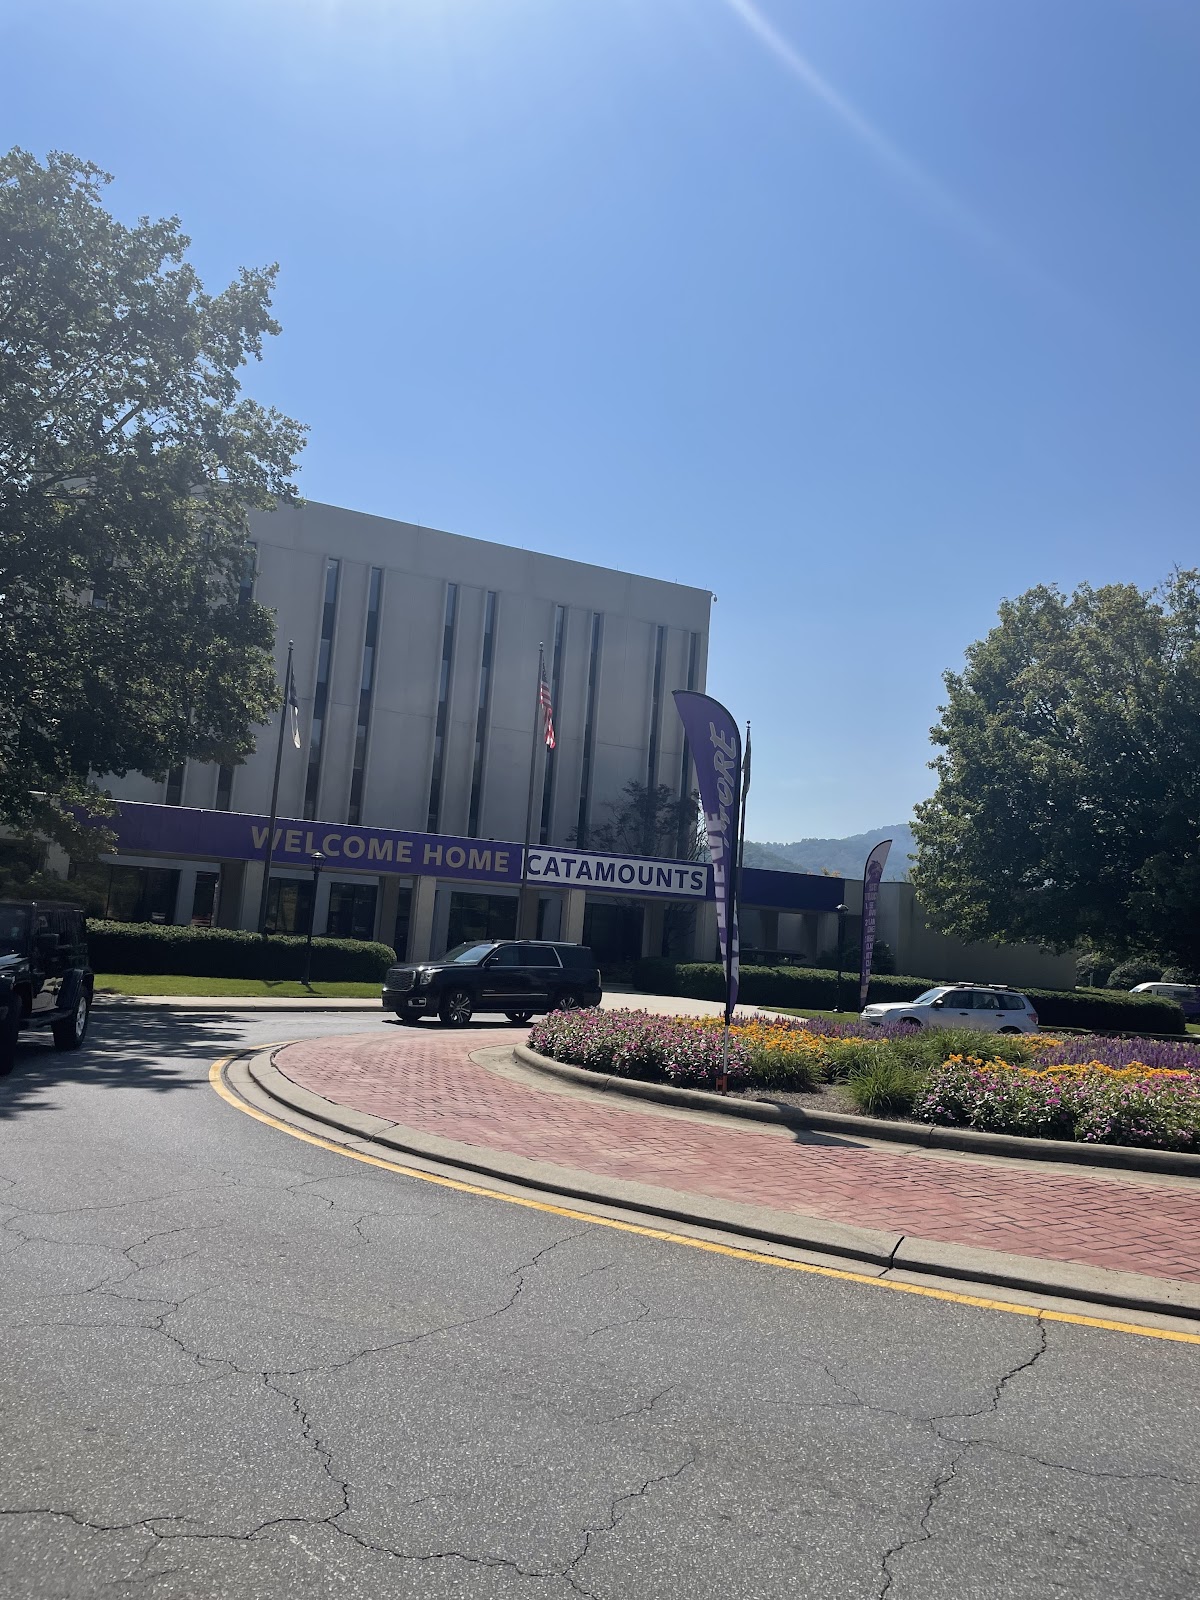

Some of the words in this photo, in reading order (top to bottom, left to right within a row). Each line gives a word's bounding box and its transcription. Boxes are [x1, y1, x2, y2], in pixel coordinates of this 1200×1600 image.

[251, 825, 412, 863] WELCOME
[423, 843, 510, 873] HOME
[526, 854, 704, 890] CATAMOUNTS
